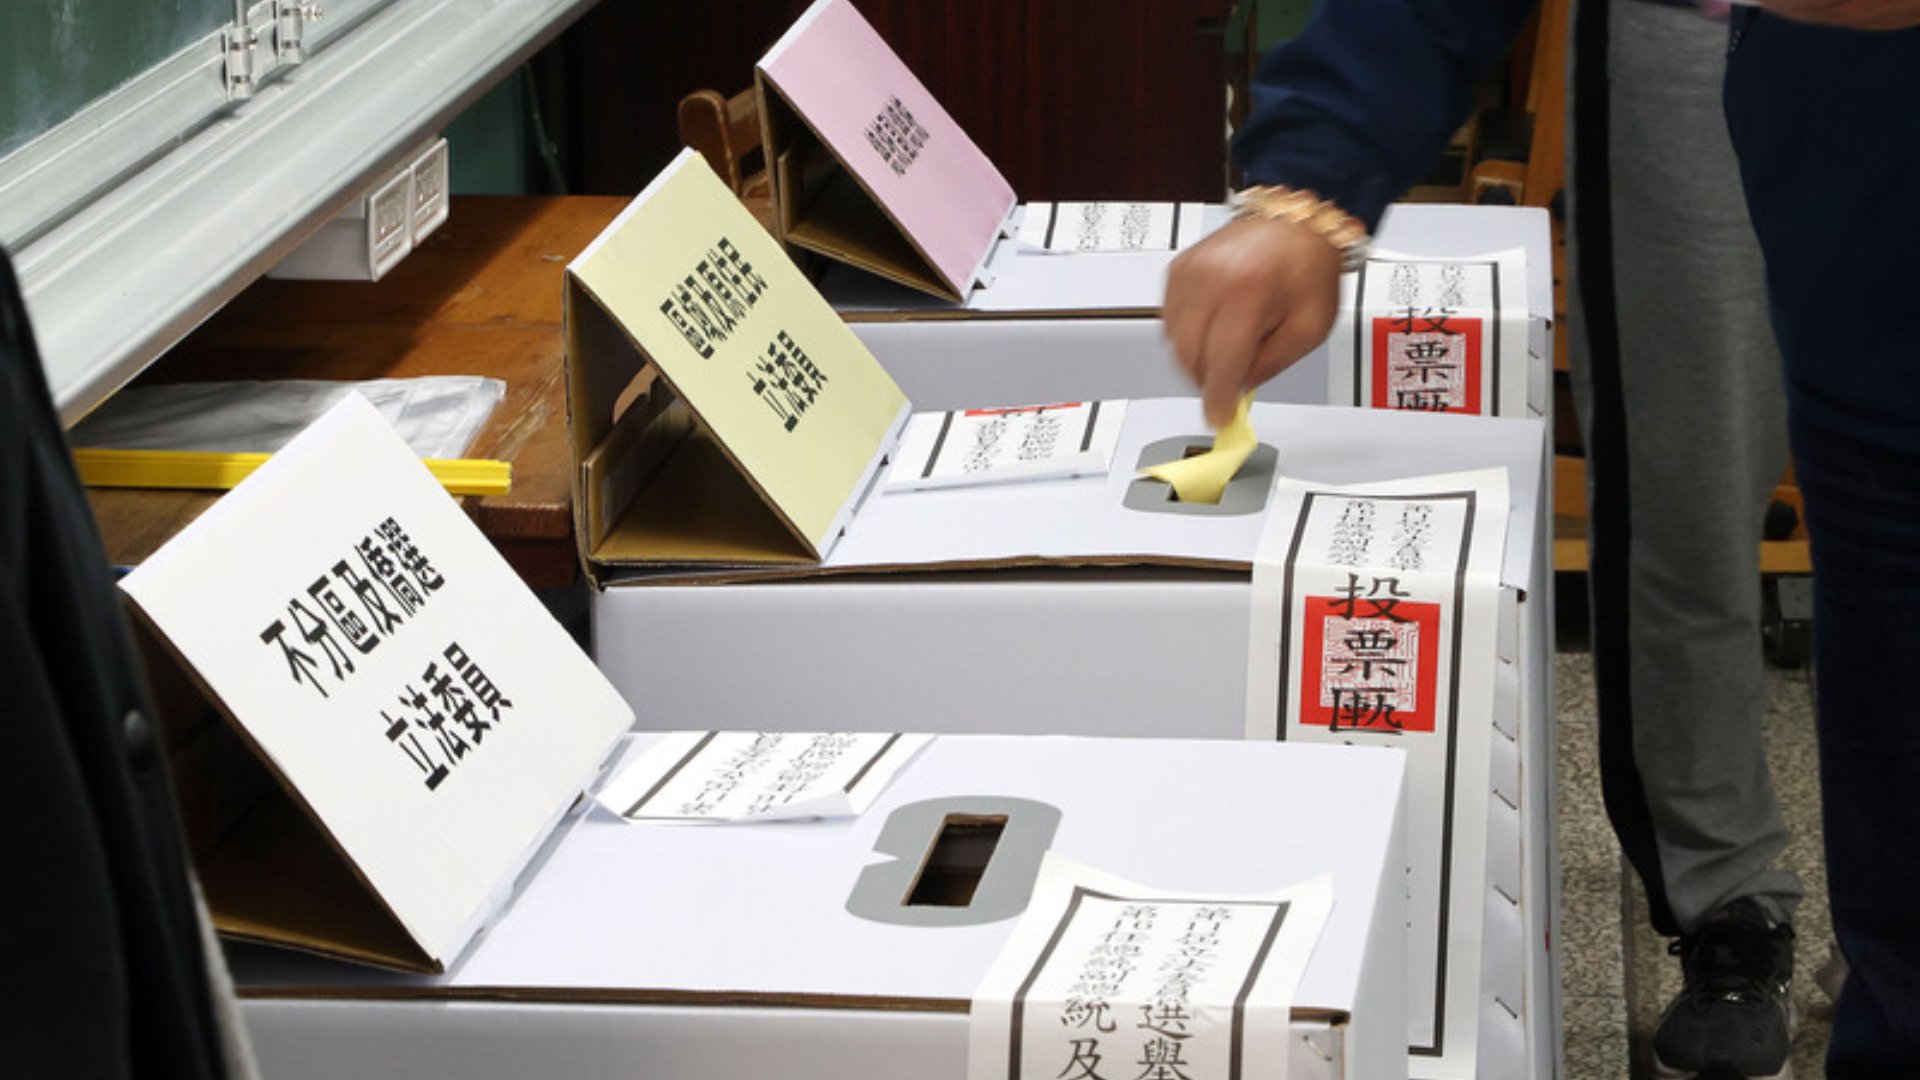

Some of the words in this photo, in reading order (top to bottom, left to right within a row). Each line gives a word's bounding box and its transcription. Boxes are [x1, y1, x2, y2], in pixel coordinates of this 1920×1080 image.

[746, 330, 828, 433] 立法委員
[260, 517, 445, 698] 不分區及僑選
[380, 641, 512, 791] 立法委員
